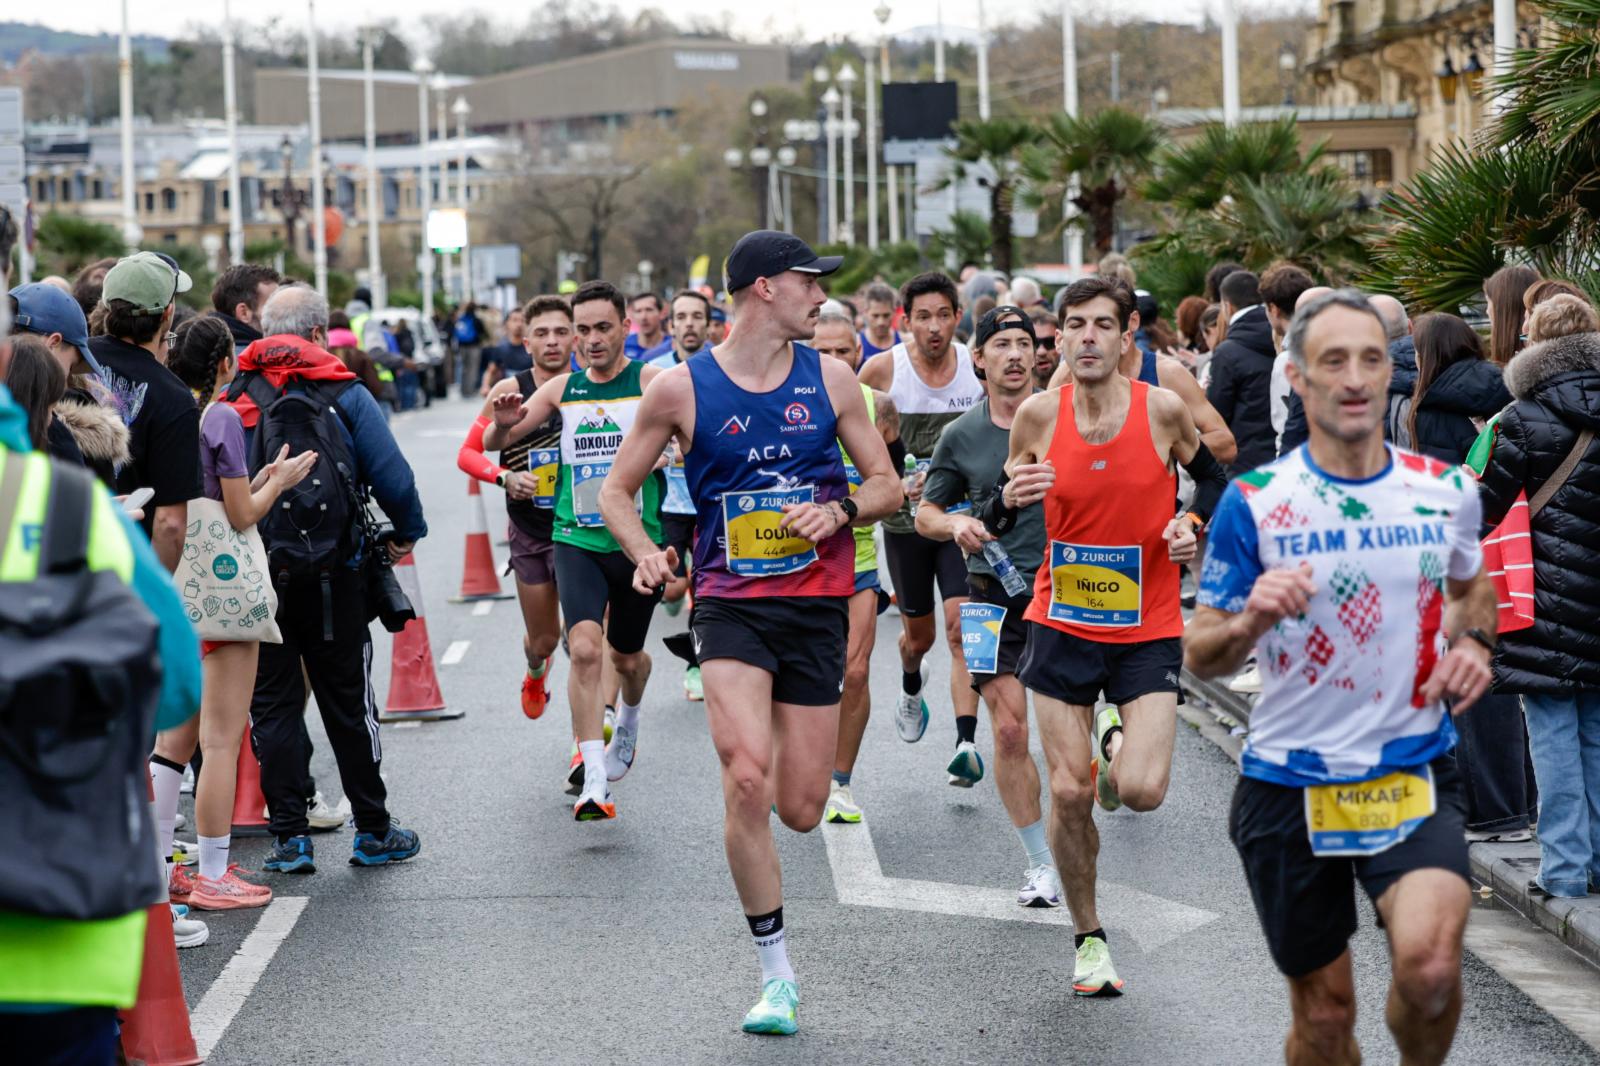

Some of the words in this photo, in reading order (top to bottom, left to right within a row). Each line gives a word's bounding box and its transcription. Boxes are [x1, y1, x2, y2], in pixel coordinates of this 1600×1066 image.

[794, 386, 816, 395] POLI
[576, 451, 599, 459] mendi
[747, 444, 792, 462] ACA
[756, 527, 791, 540] LOUI
[1274, 529, 1347, 557] TEAM
[764, 547, 786, 556] 444
[1081, 552, 1125, 562] ZURICH
[1077, 578, 1120, 593] IÑIGO
[1087, 597, 1104, 608] 164
[961, 608, 992, 617] ZURICH
[1336, 784, 1415, 805] MIKAEL
[1359, 813, 1391, 828] 820
